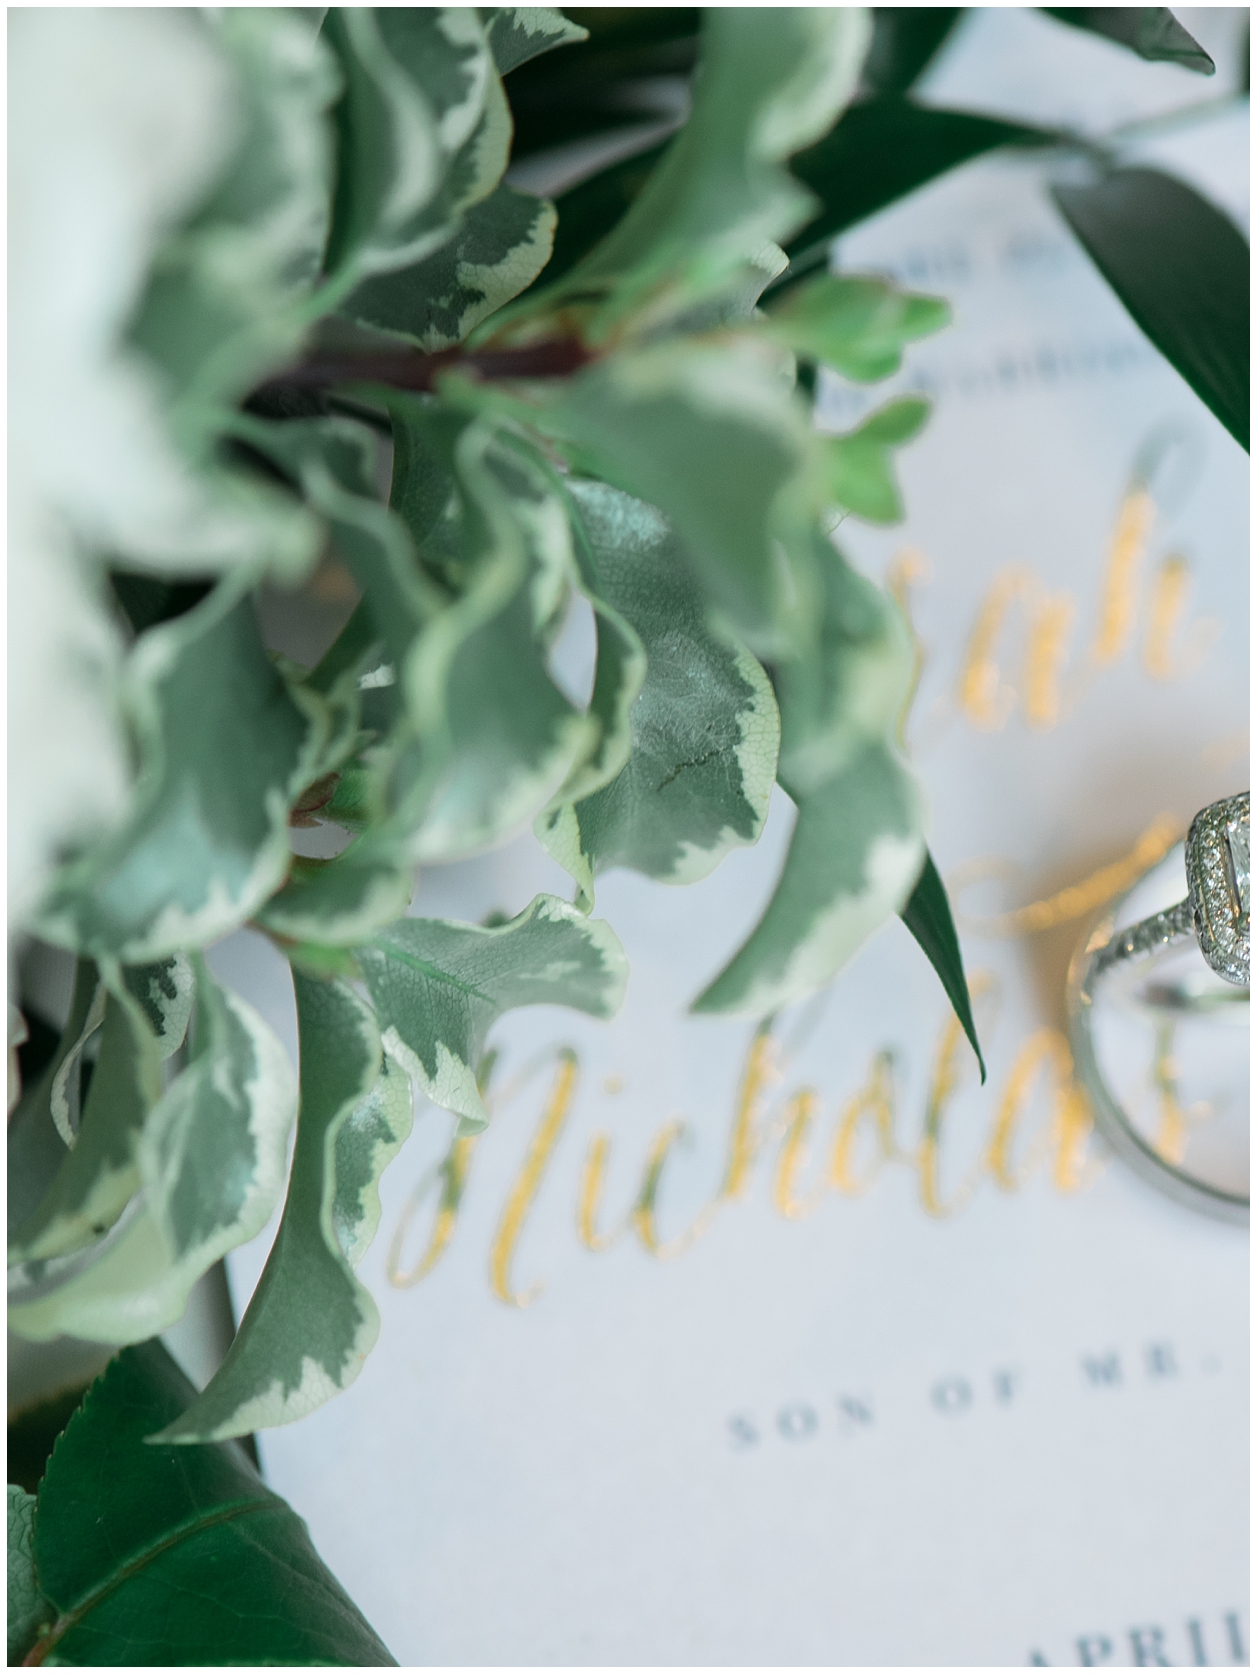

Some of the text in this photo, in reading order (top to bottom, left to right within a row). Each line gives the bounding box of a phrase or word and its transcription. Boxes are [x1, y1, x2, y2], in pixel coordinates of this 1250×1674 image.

[724, 1391, 877, 1453] SON
[927, 1365, 1023, 1418] OF
[1076, 1338, 1222, 1391] MR.
